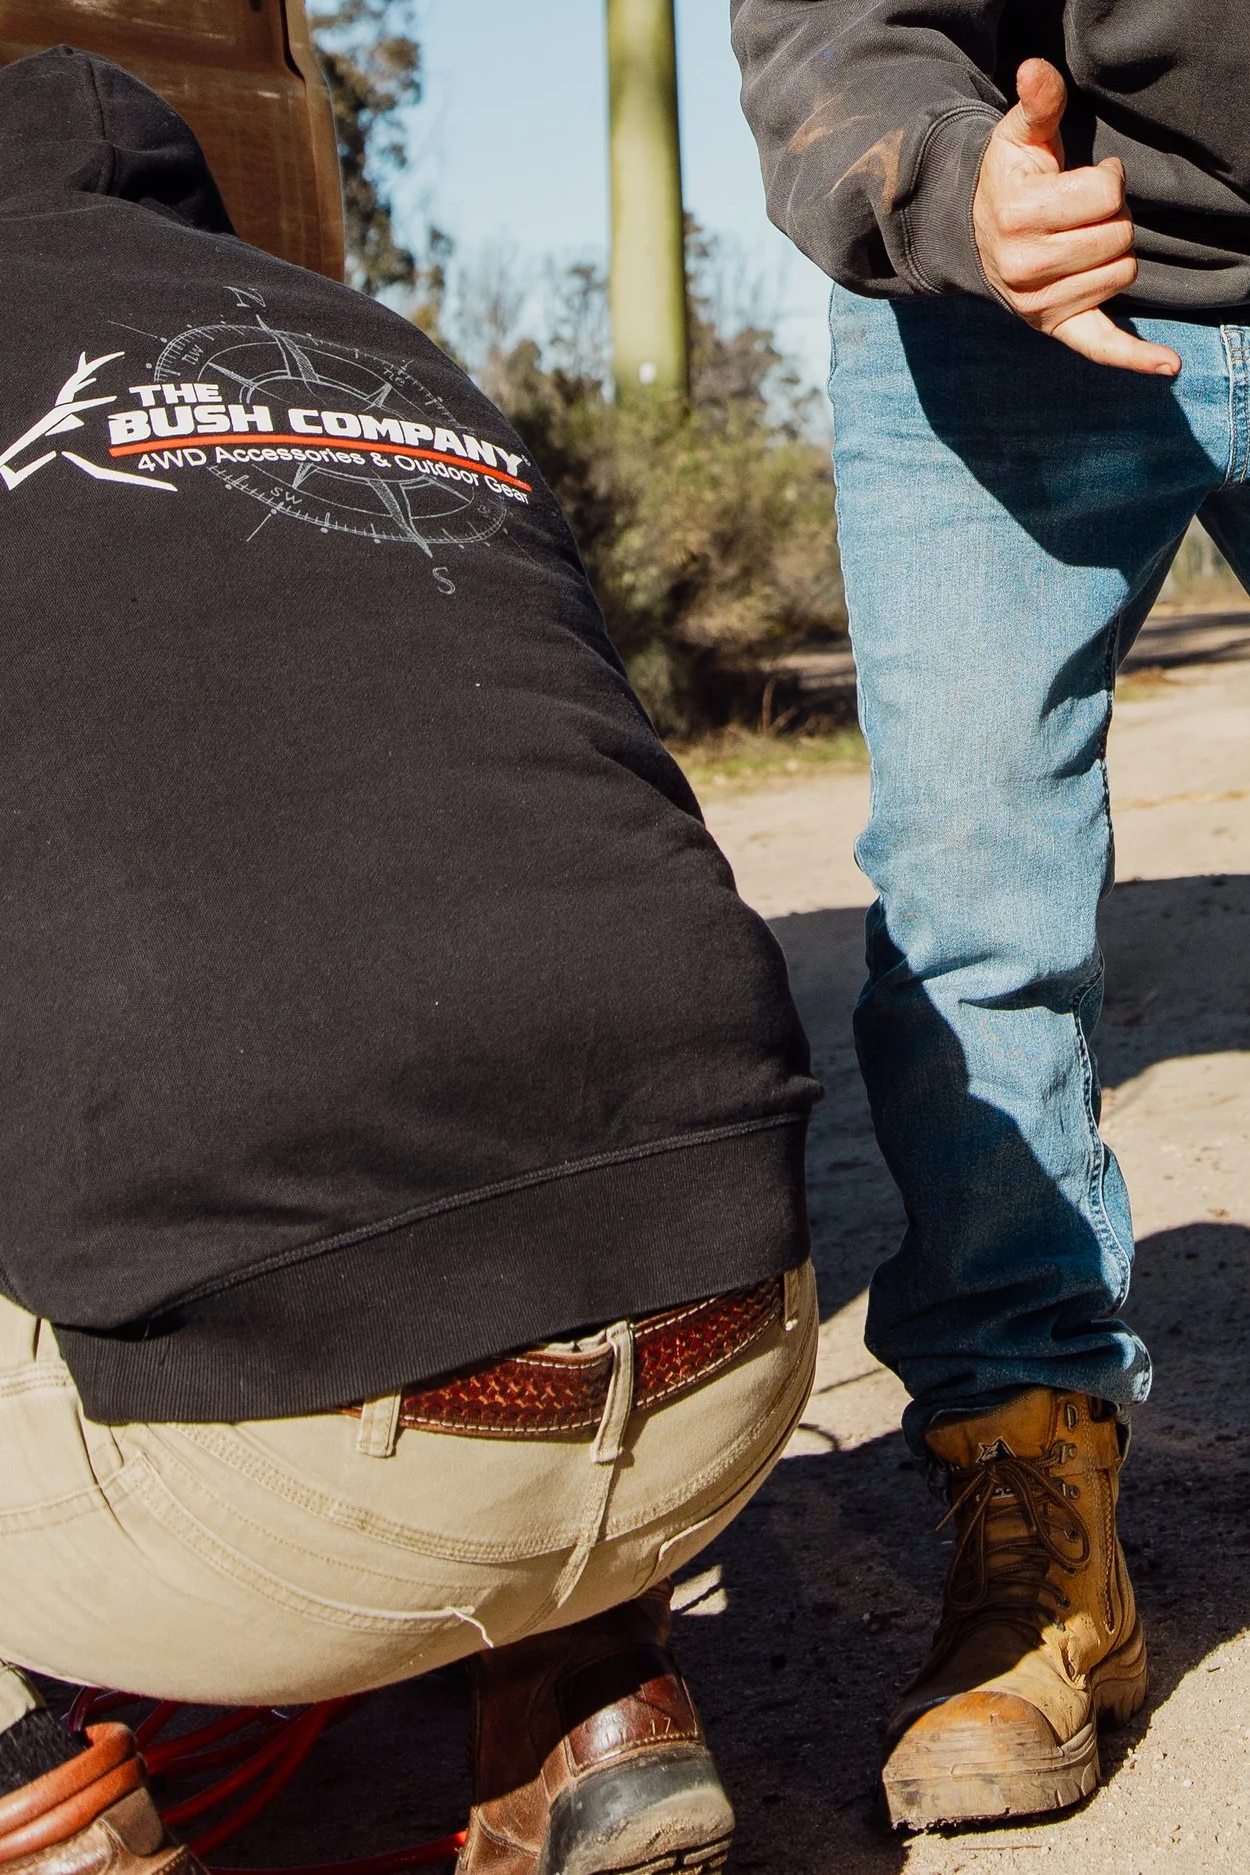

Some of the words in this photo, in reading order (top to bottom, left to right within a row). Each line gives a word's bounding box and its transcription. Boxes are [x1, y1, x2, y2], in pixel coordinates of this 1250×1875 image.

[128, 383, 223, 407] THE
[107, 404, 274, 445] BUSH
[137, 448, 207, 472] 4WD
[215, 446, 366, 466] Accessories
[370, 450, 391, 469] &
[394, 454, 480, 487] Outdoor
[484, 474, 530, 505] Gear
